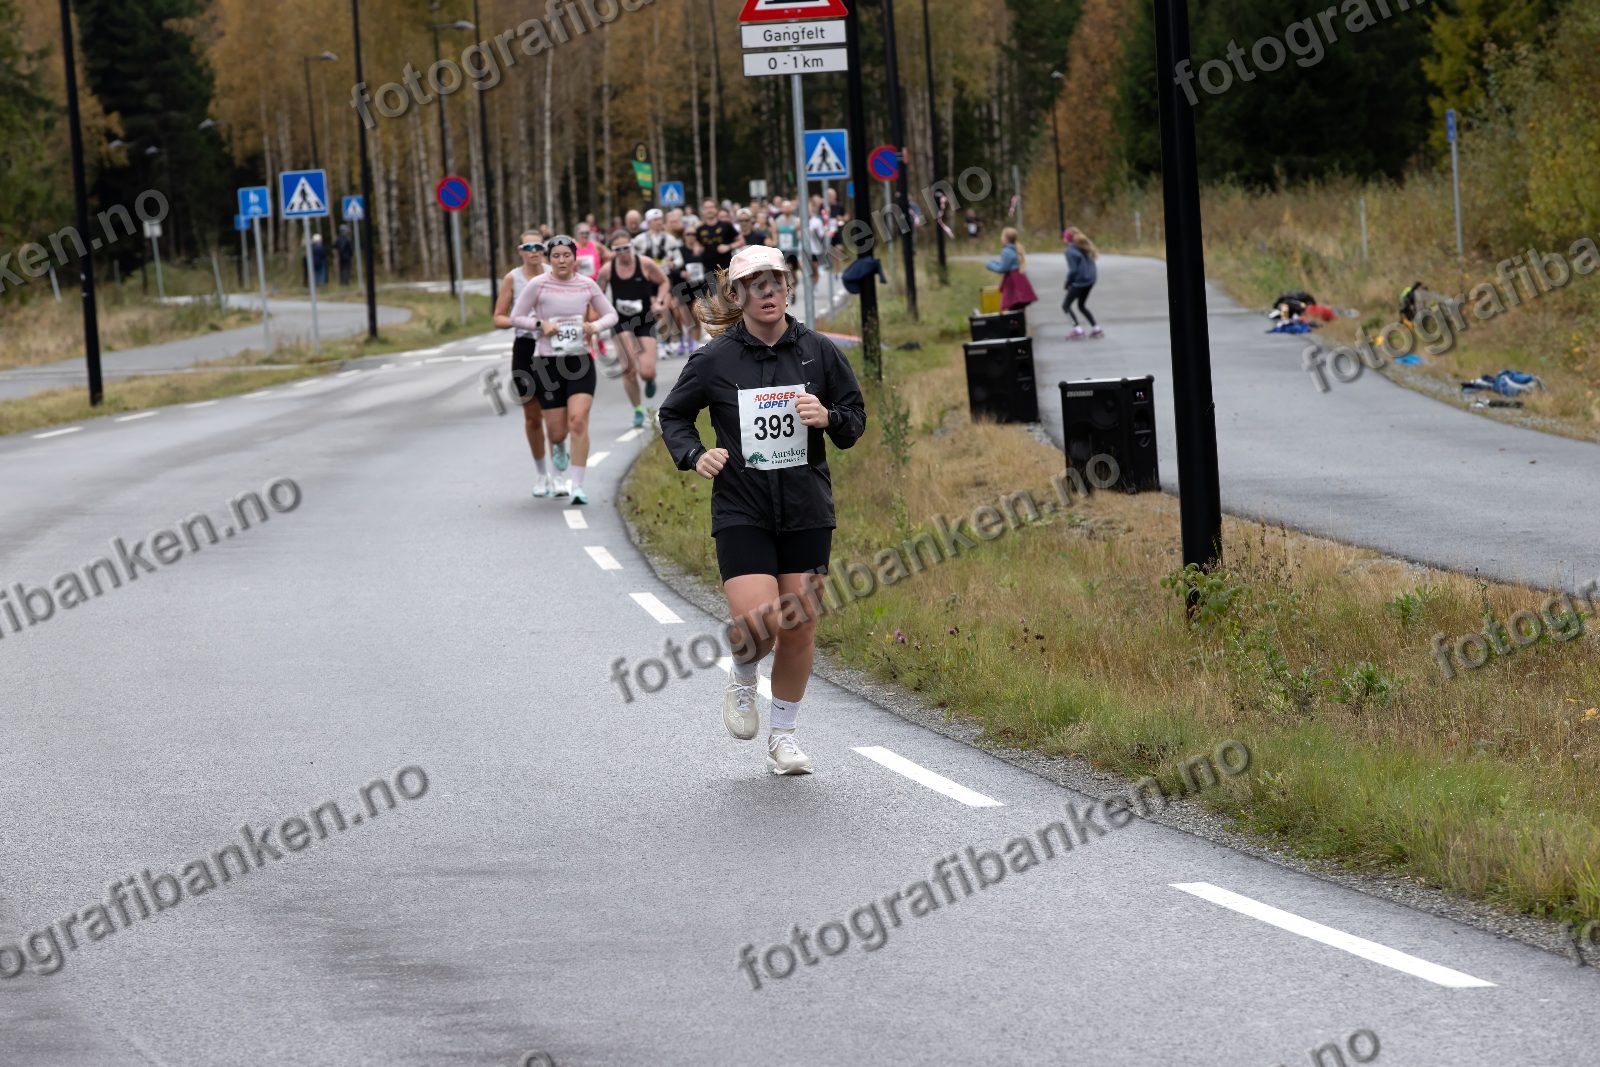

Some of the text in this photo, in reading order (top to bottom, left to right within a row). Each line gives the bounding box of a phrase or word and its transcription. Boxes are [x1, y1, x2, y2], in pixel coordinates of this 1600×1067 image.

[763, 27, 825, 43] Gangfelt
[803, 56, 824, 68] km
[557, 329, 576, 341] 649
[755, 392, 795, 402] NORGES
[759, 400, 789, 409] LØPET
[754, 414, 795, 440] 393
[772, 448, 806, 458] Aurskog
